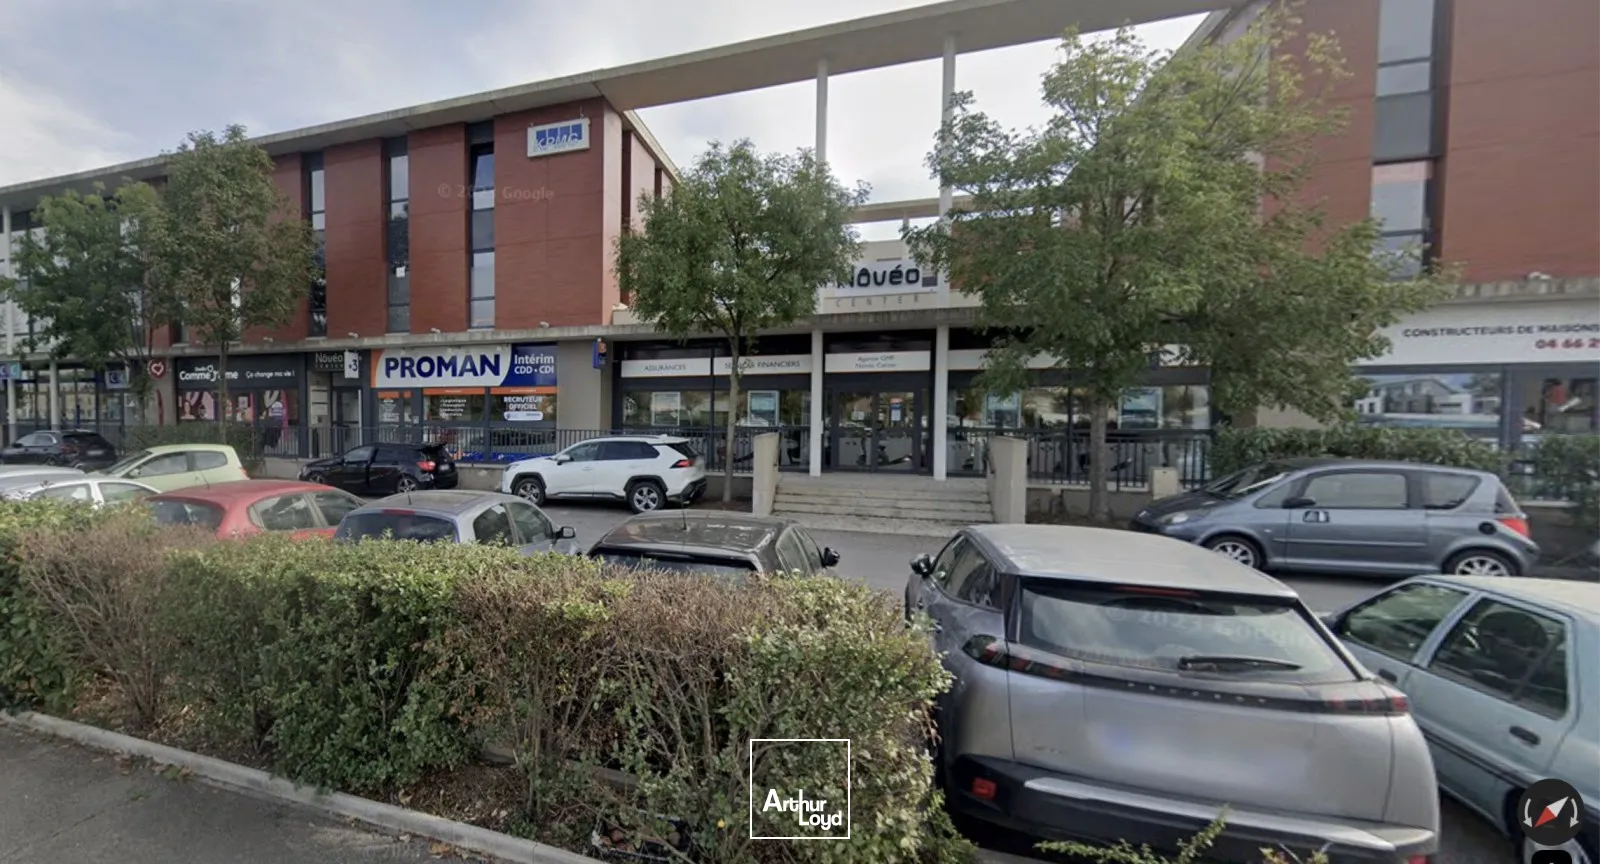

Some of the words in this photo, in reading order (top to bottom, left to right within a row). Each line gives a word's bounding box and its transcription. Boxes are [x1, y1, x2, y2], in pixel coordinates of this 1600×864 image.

[536, 132, 580, 150] KPMG
[1402, 325, 1514, 338] CONSTRUCTEURS
[1517, 325, 1534, 335] DE
[514, 354, 554, 365] Intérim
[757, 360, 801, 369] FINANCIERS
[384, 354, 500, 379] PROMAN
[514, 365, 532, 375] CDD
[539, 365, 554, 374] CDI
[643, 363, 687, 372] ASSURANCES
